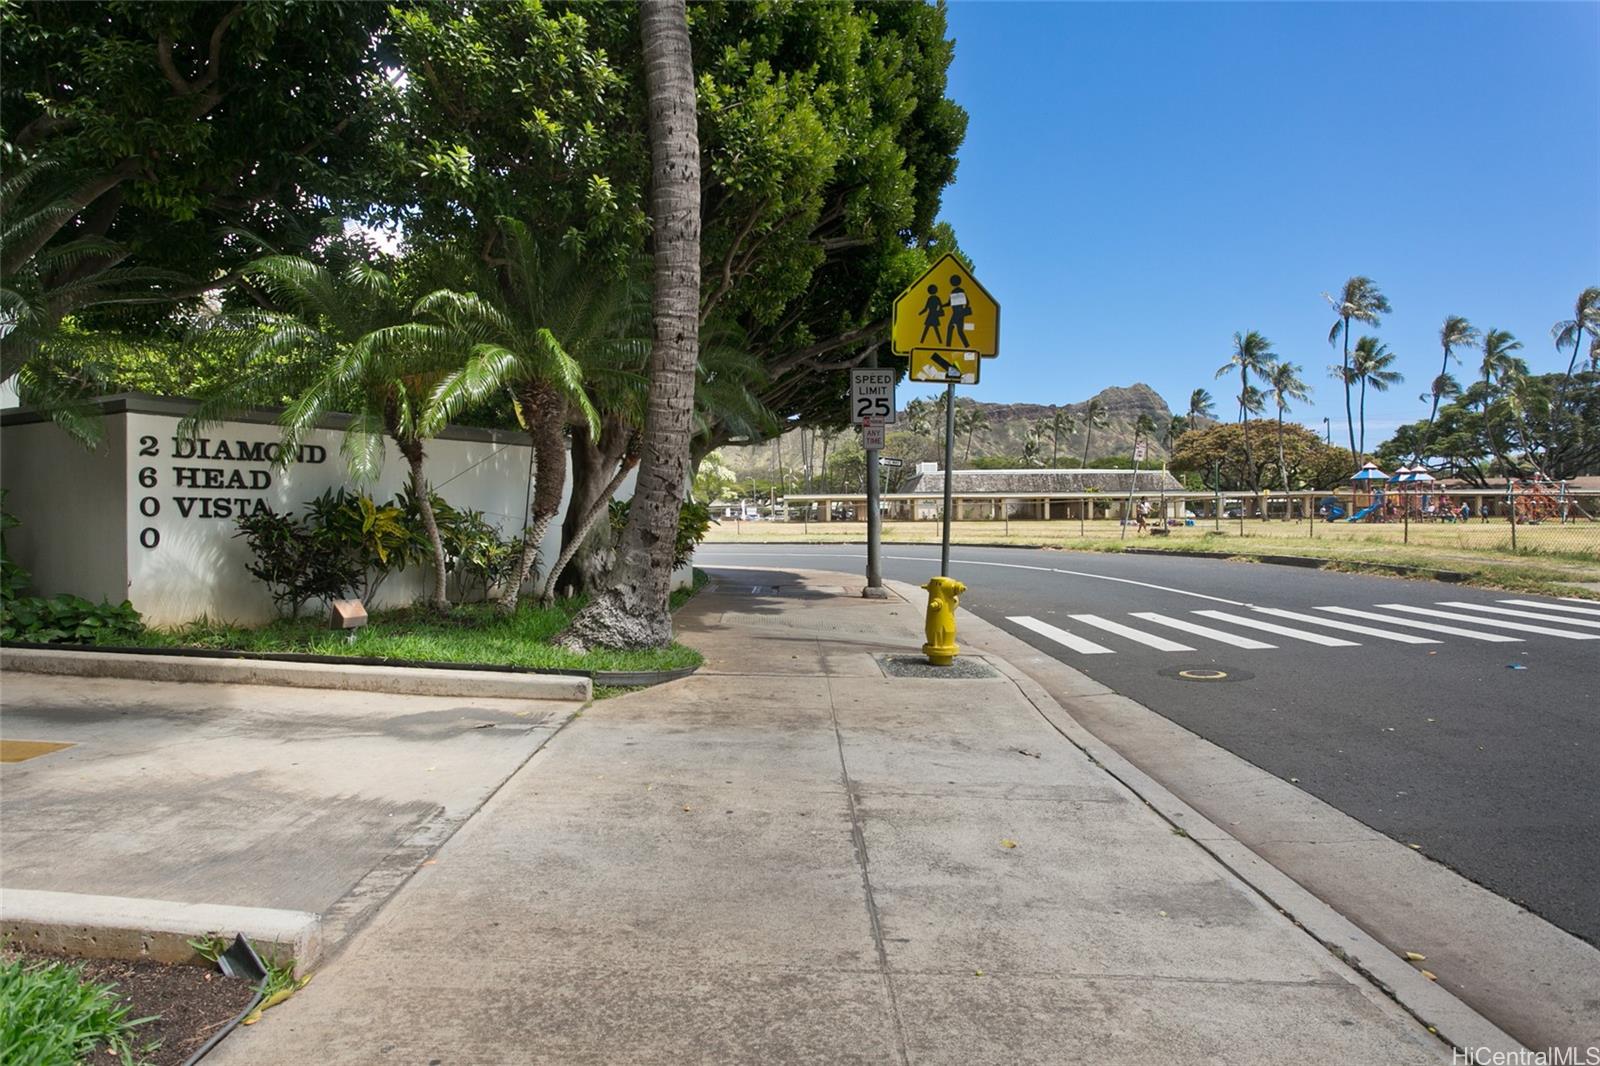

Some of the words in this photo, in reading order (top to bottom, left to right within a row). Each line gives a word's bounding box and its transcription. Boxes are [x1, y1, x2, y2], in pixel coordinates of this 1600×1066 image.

[855, 375, 891, 384] SPEED
[859, 387, 887, 396] LIMIT
[857, 398, 890, 417] 25
[867, 437, 881, 445] TIME
[172, 467, 272, 490] HEAD
[173, 497, 271, 519] VISTA
